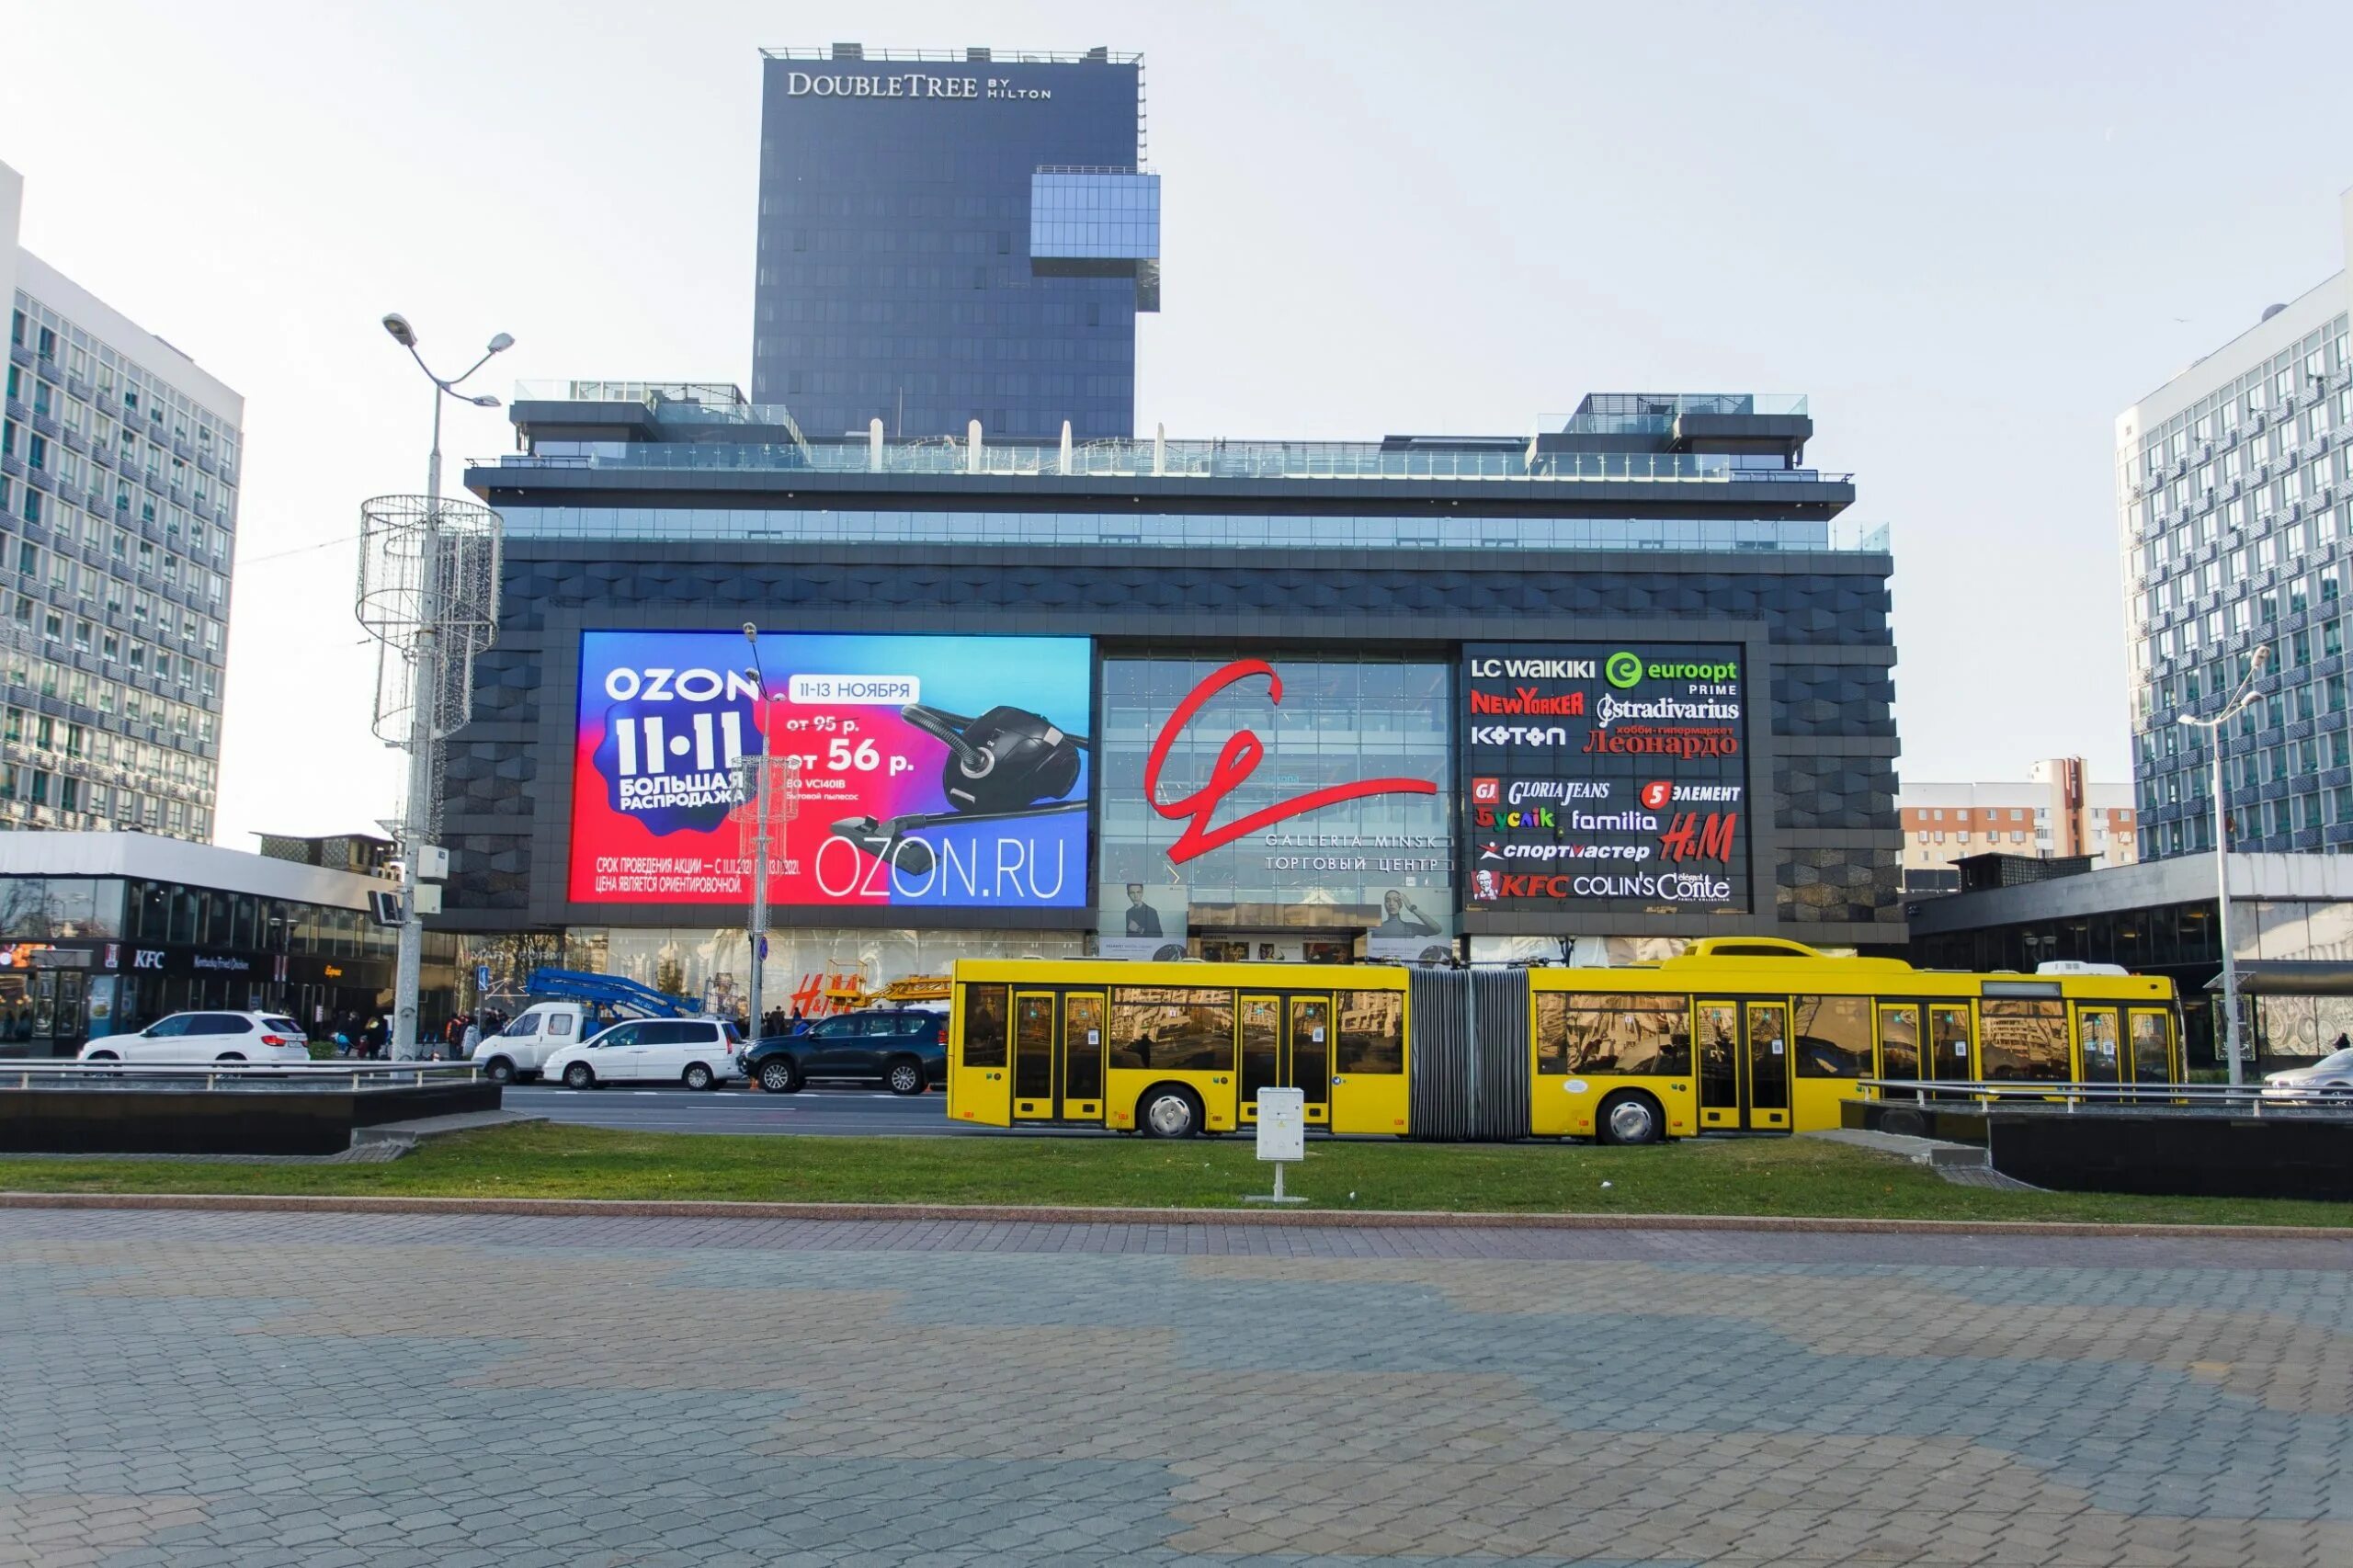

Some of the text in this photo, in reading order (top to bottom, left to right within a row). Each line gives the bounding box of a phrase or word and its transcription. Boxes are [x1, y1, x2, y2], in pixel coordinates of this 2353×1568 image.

[787, 72, 979, 98] DOUBLETREE
[987, 78, 1010, 89] BY
[987, 89, 1052, 100] HILTON
[1471, 659, 1501, 678] LC
[1648, 661, 1737, 683] euroopt
[605, 667, 760, 702] OZON
[800, 682, 910, 699] 11-13 НОЯБРЯ
[1688, 684, 1737, 696] PRIME
[787, 720, 809, 732] от
[813, 715, 837, 732] 95
[1582, 729, 1738, 760] Леонардо
[787, 738, 915, 778] от 56 р.
[620, 770, 744, 798] БОЛЬШАЯ
[1508, 781, 1610, 807] GLORIA JEANS
[1671, 786, 1741, 802] ЭЛЕМЕНТ
[620, 789, 745, 811] РАСПРОДАЖА
[824, 792, 859, 801] пылесос
[1572, 810, 1657, 832] familia
[1265, 834, 1437, 849] GALLERIA MINSK
[1658, 811, 1737, 863] H&M
[1503, 843, 1651, 862] спортмастер
[597, 857, 619, 874] СРОК
[620, 857, 673, 876] ПРОВЕДЕНИЯ
[673, 858, 702, 875] АКЦИИ
[815, 835, 1064, 899] OZON.RU
[1265, 856, 1438, 874] ТОРГОВЫЙ ЦЕНТР
[595, 876, 617, 894] ЦЕНА
[619, 876, 657, 892] ЯВЛЯЕТСЯ
[1498, 874, 1571, 899] KFC
[1573, 871, 1655, 897] COLIN'S
[1656, 872, 1731, 900] Conte
[133, 949, 165, 969] KFC
